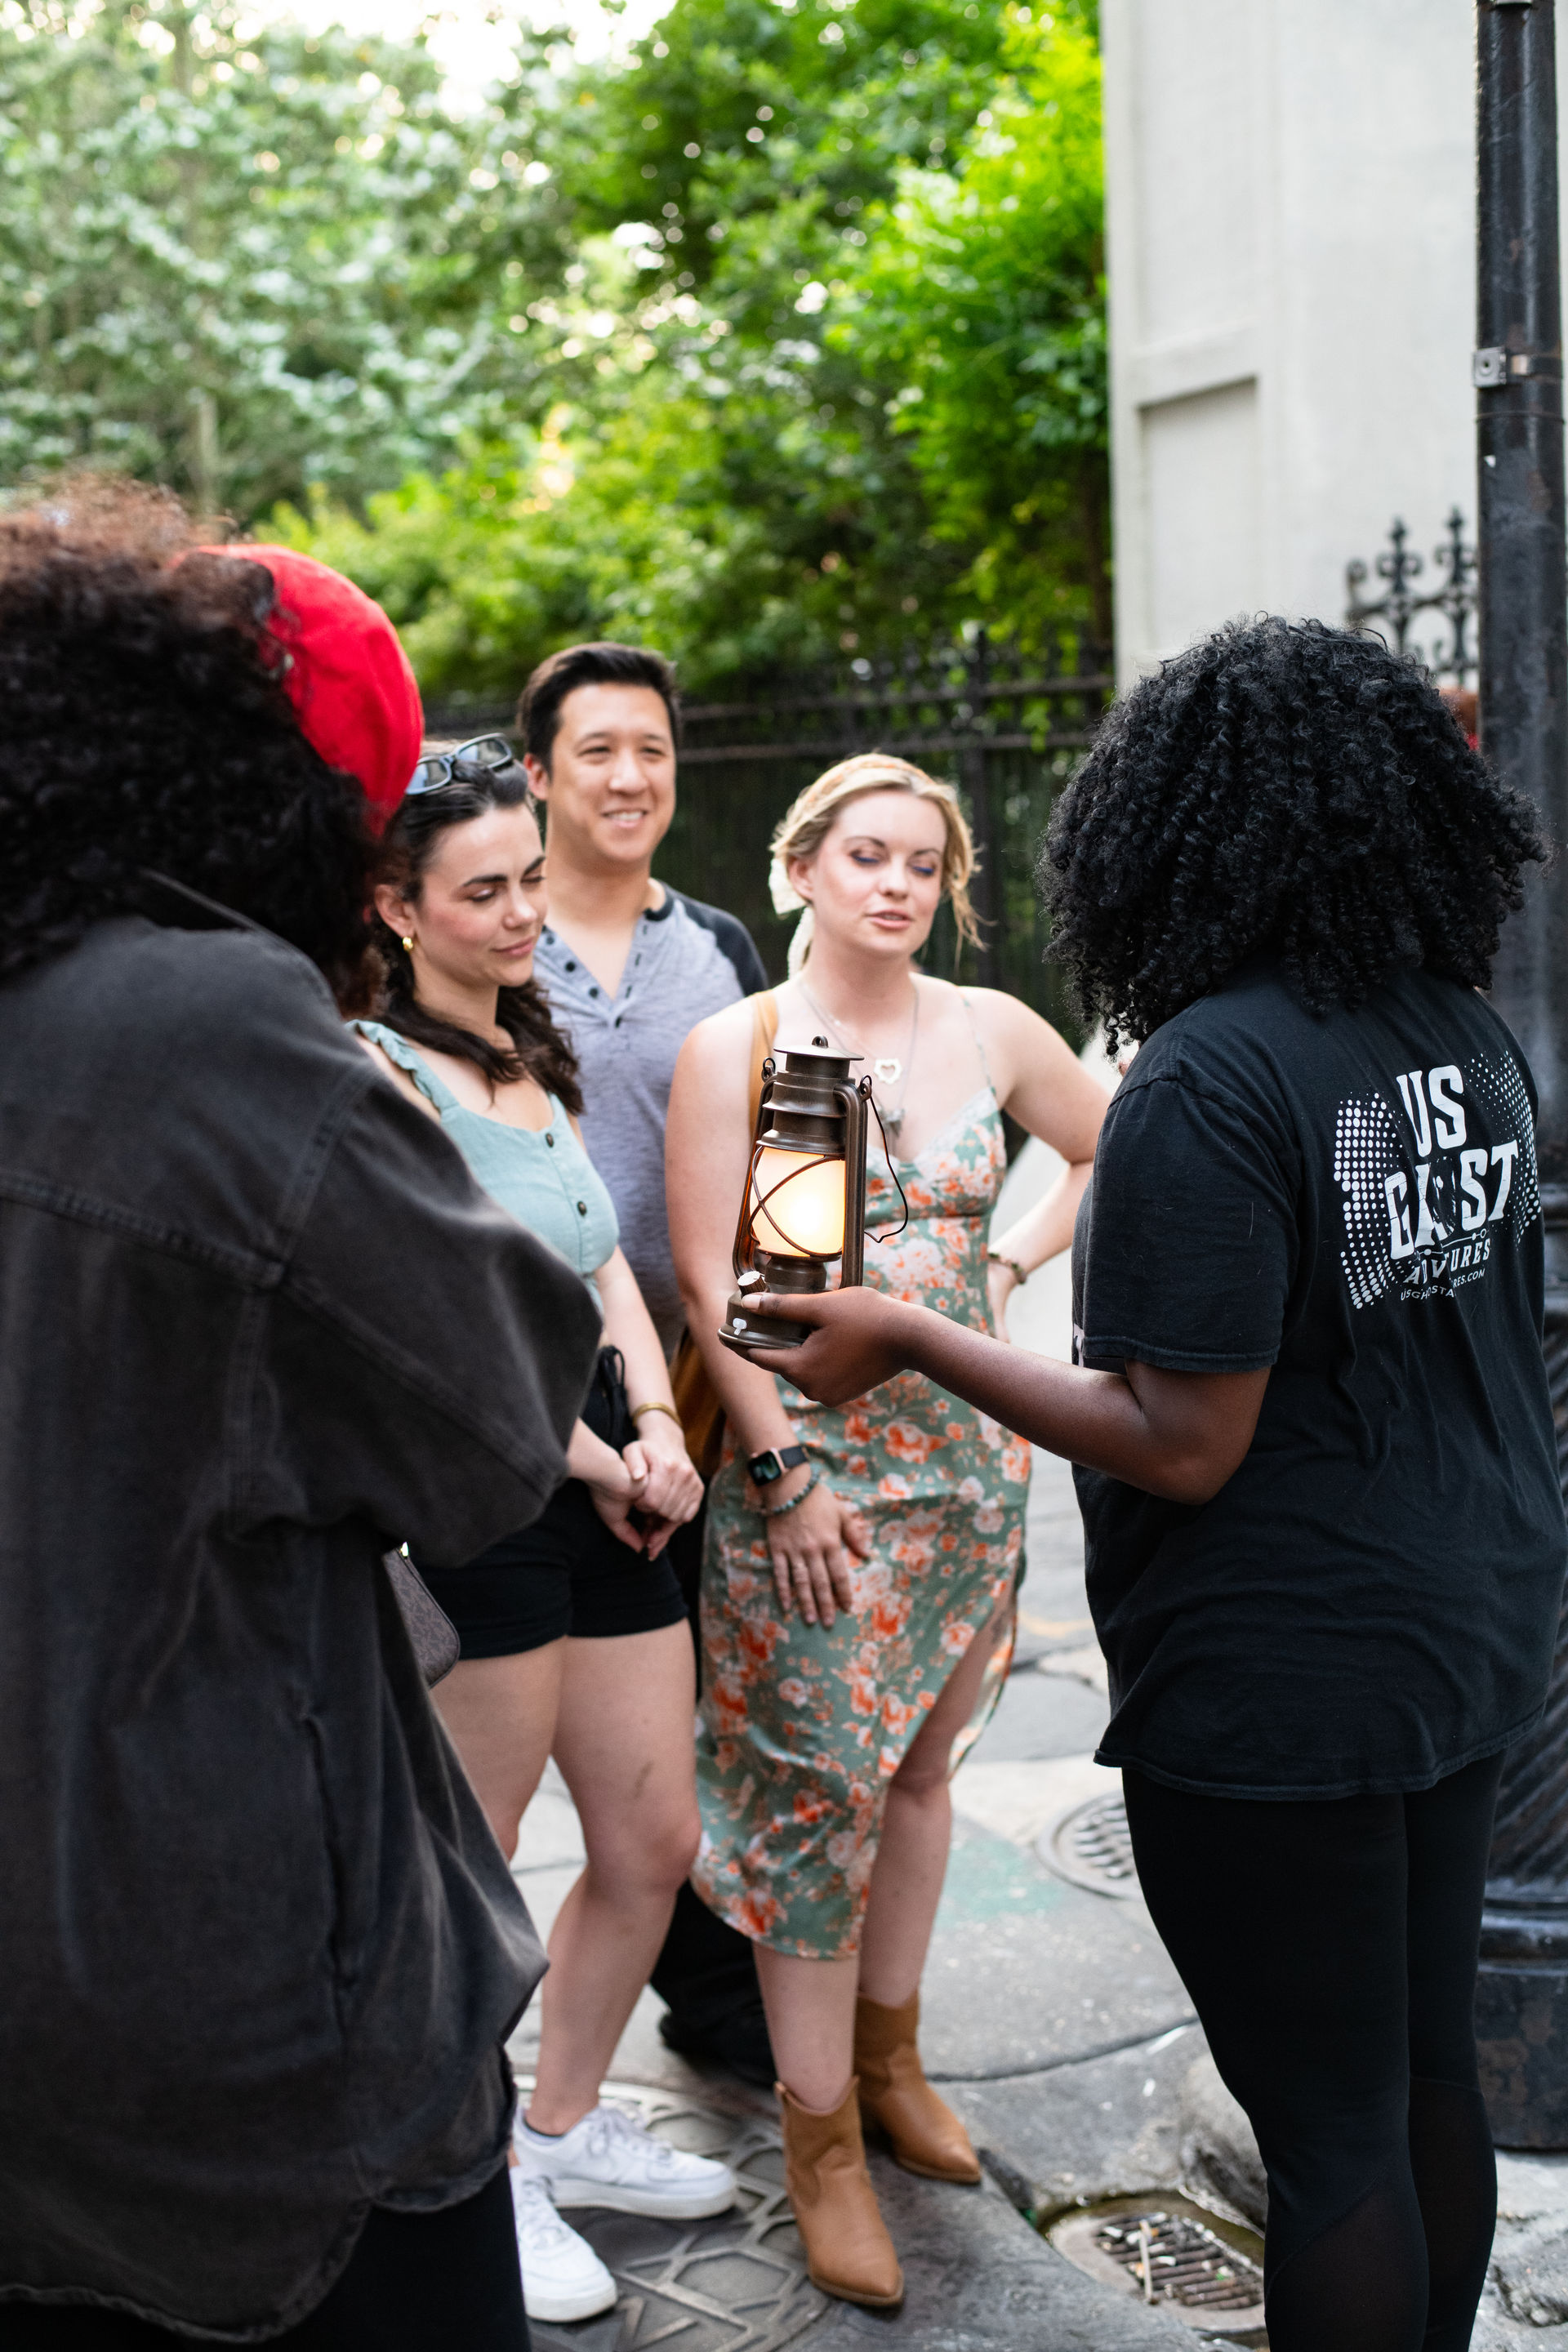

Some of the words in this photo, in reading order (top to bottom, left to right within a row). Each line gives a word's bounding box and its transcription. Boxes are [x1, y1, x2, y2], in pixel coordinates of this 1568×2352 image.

[1396, 1065, 1466, 1157] US
[1384, 1140, 1518, 1260] GST
[1403, 1238, 1490, 1285] ADVURES
